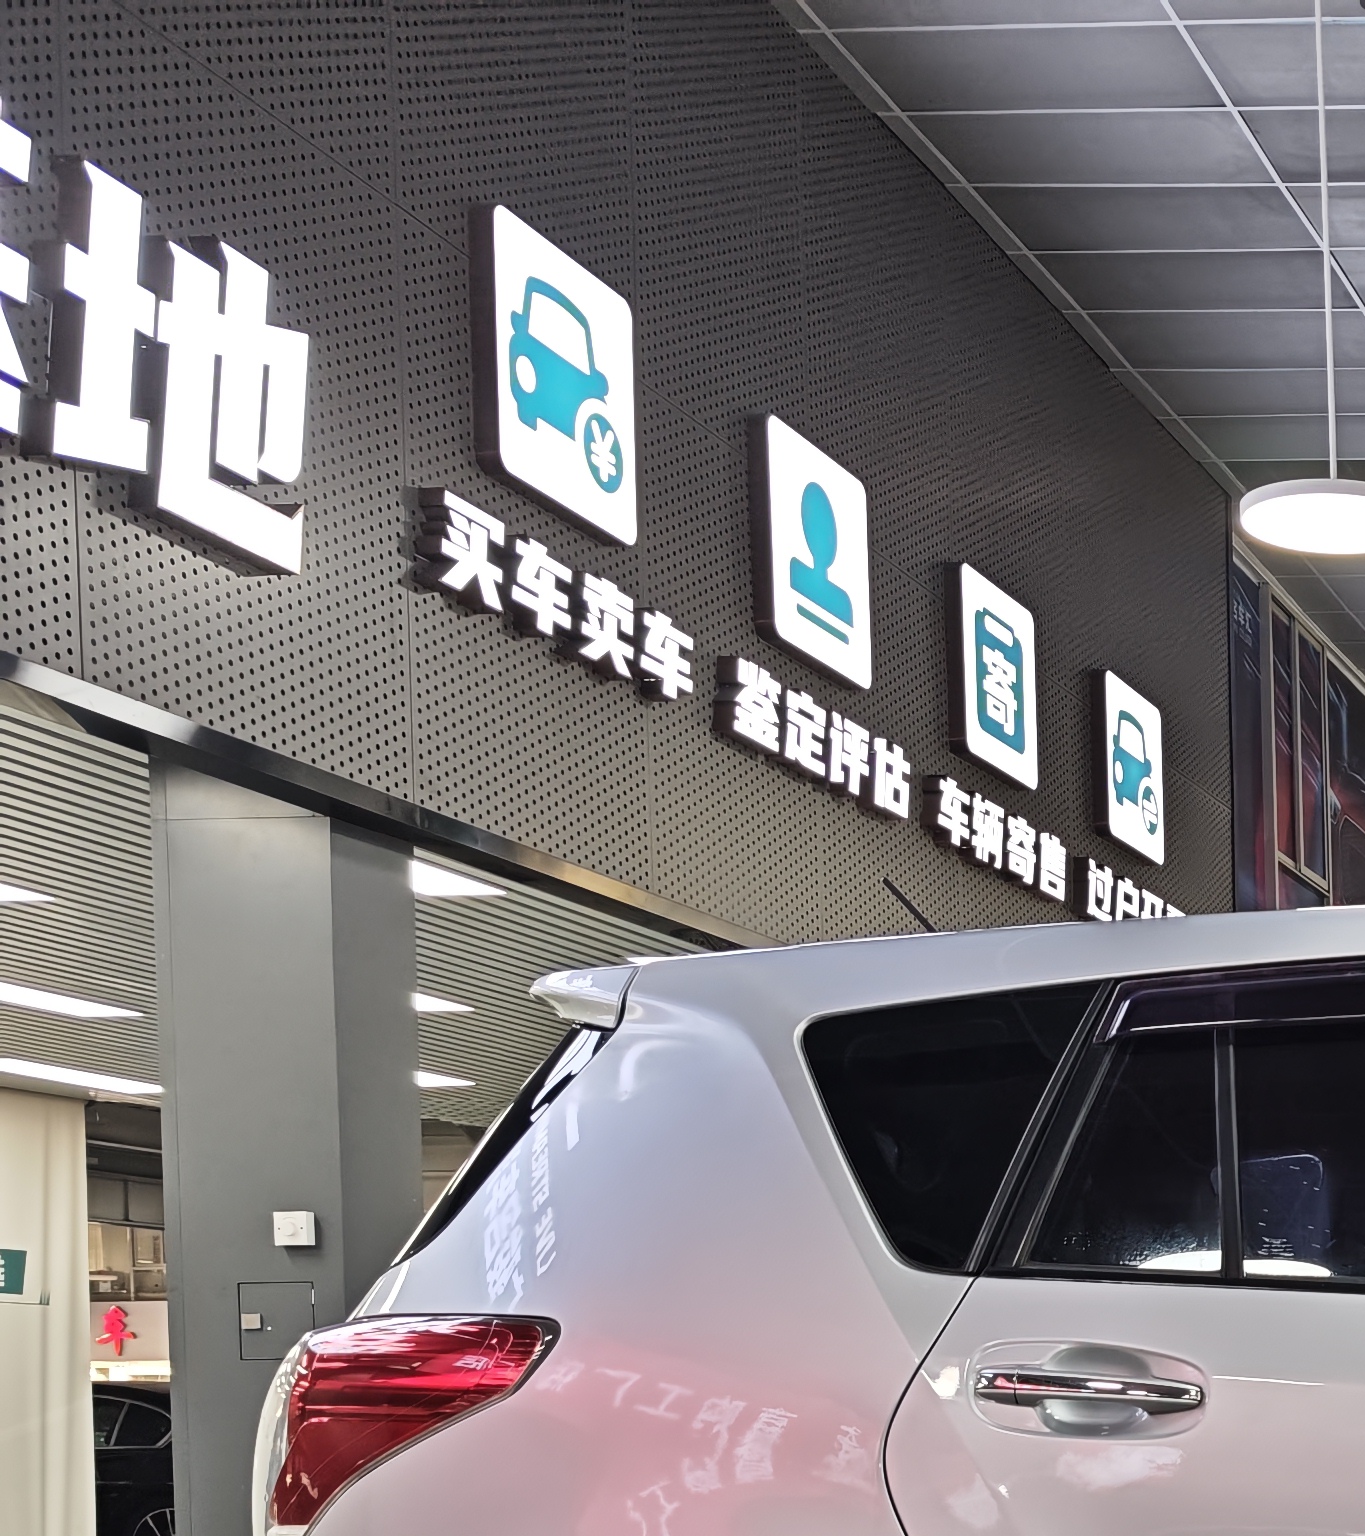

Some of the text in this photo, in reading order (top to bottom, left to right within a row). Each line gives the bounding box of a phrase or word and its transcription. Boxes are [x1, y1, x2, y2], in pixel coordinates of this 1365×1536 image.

[0, 116, 309, 576] 地
[437, 487, 694, 700] 买车卖车
[734, 656, 911, 819] 鉴定评估
[936, 776, 1068, 902] 车辆寄售
[1087, 857, 1187, 921] 过户开
